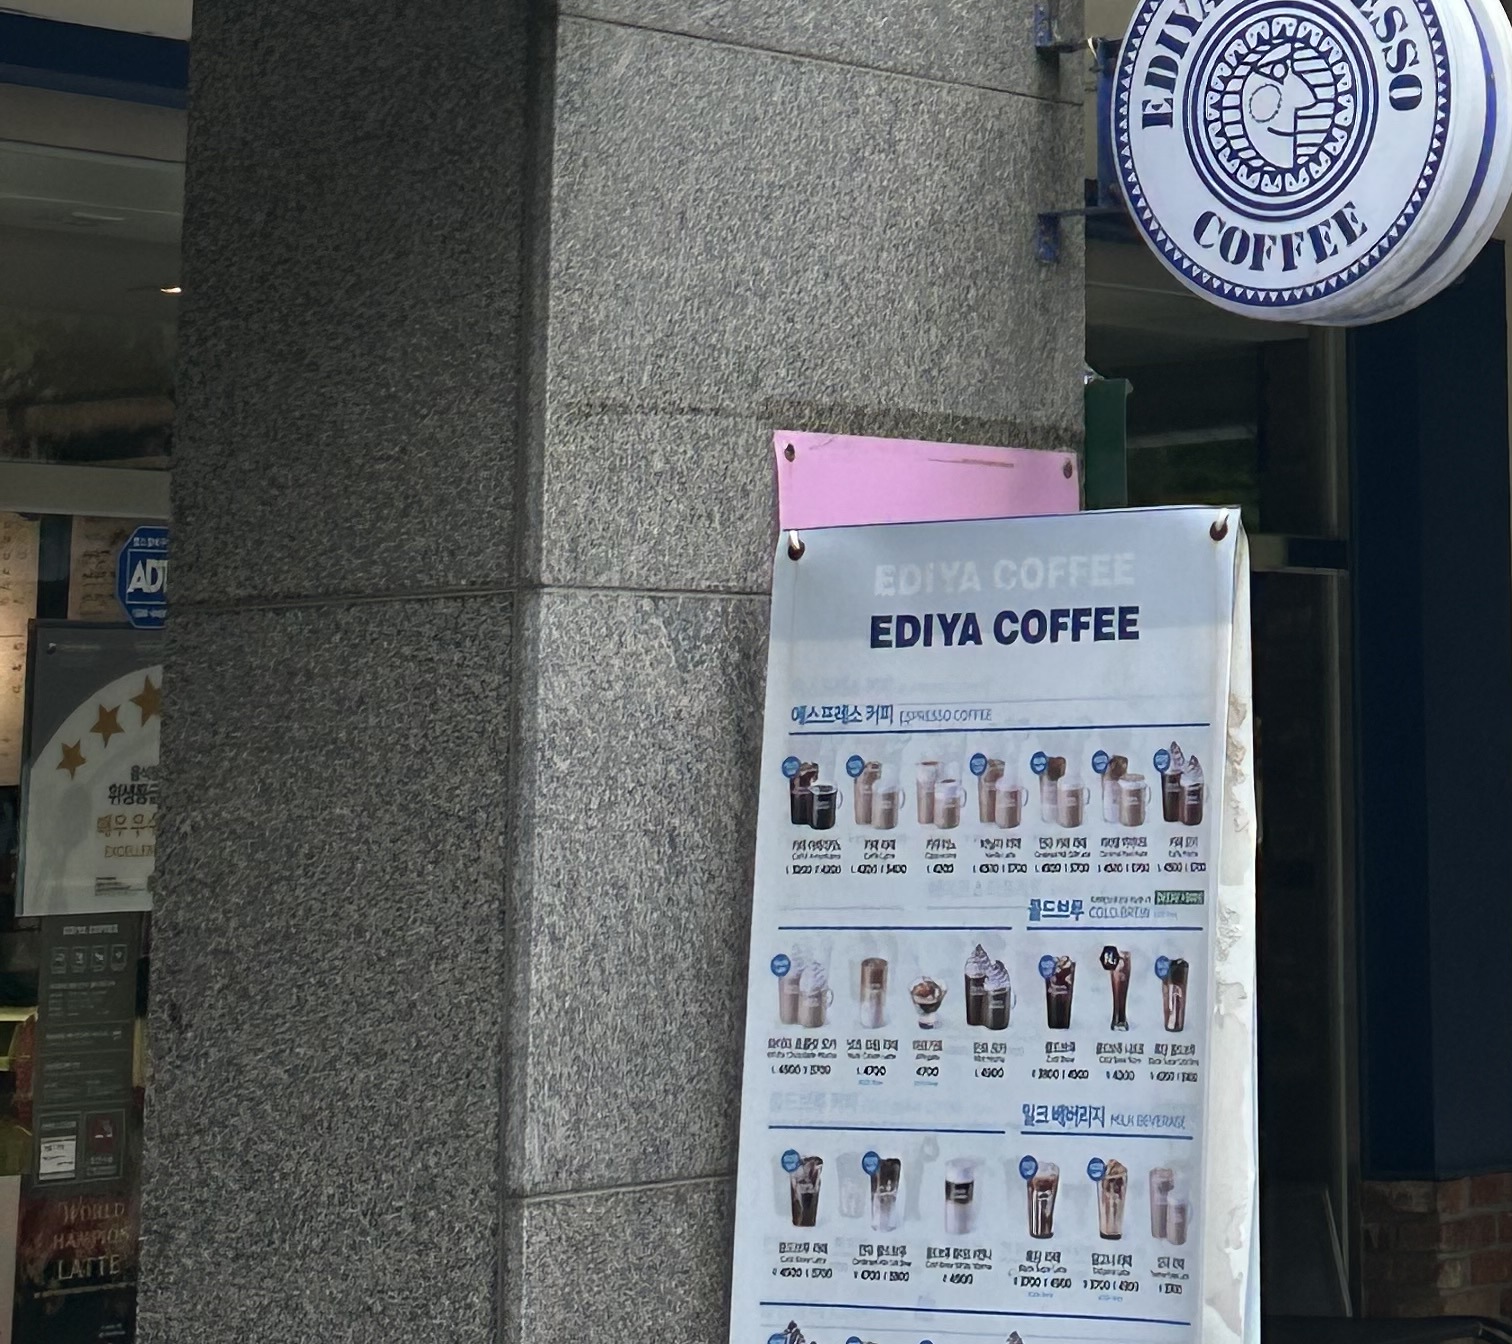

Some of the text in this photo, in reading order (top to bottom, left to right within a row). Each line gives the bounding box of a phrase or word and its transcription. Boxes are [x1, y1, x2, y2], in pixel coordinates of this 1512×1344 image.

[1192, 200, 1369, 273] COFFEE
[869, 605, 1140, 649] EDIYA COFFEE
[865, 703, 895, 726] 커피
